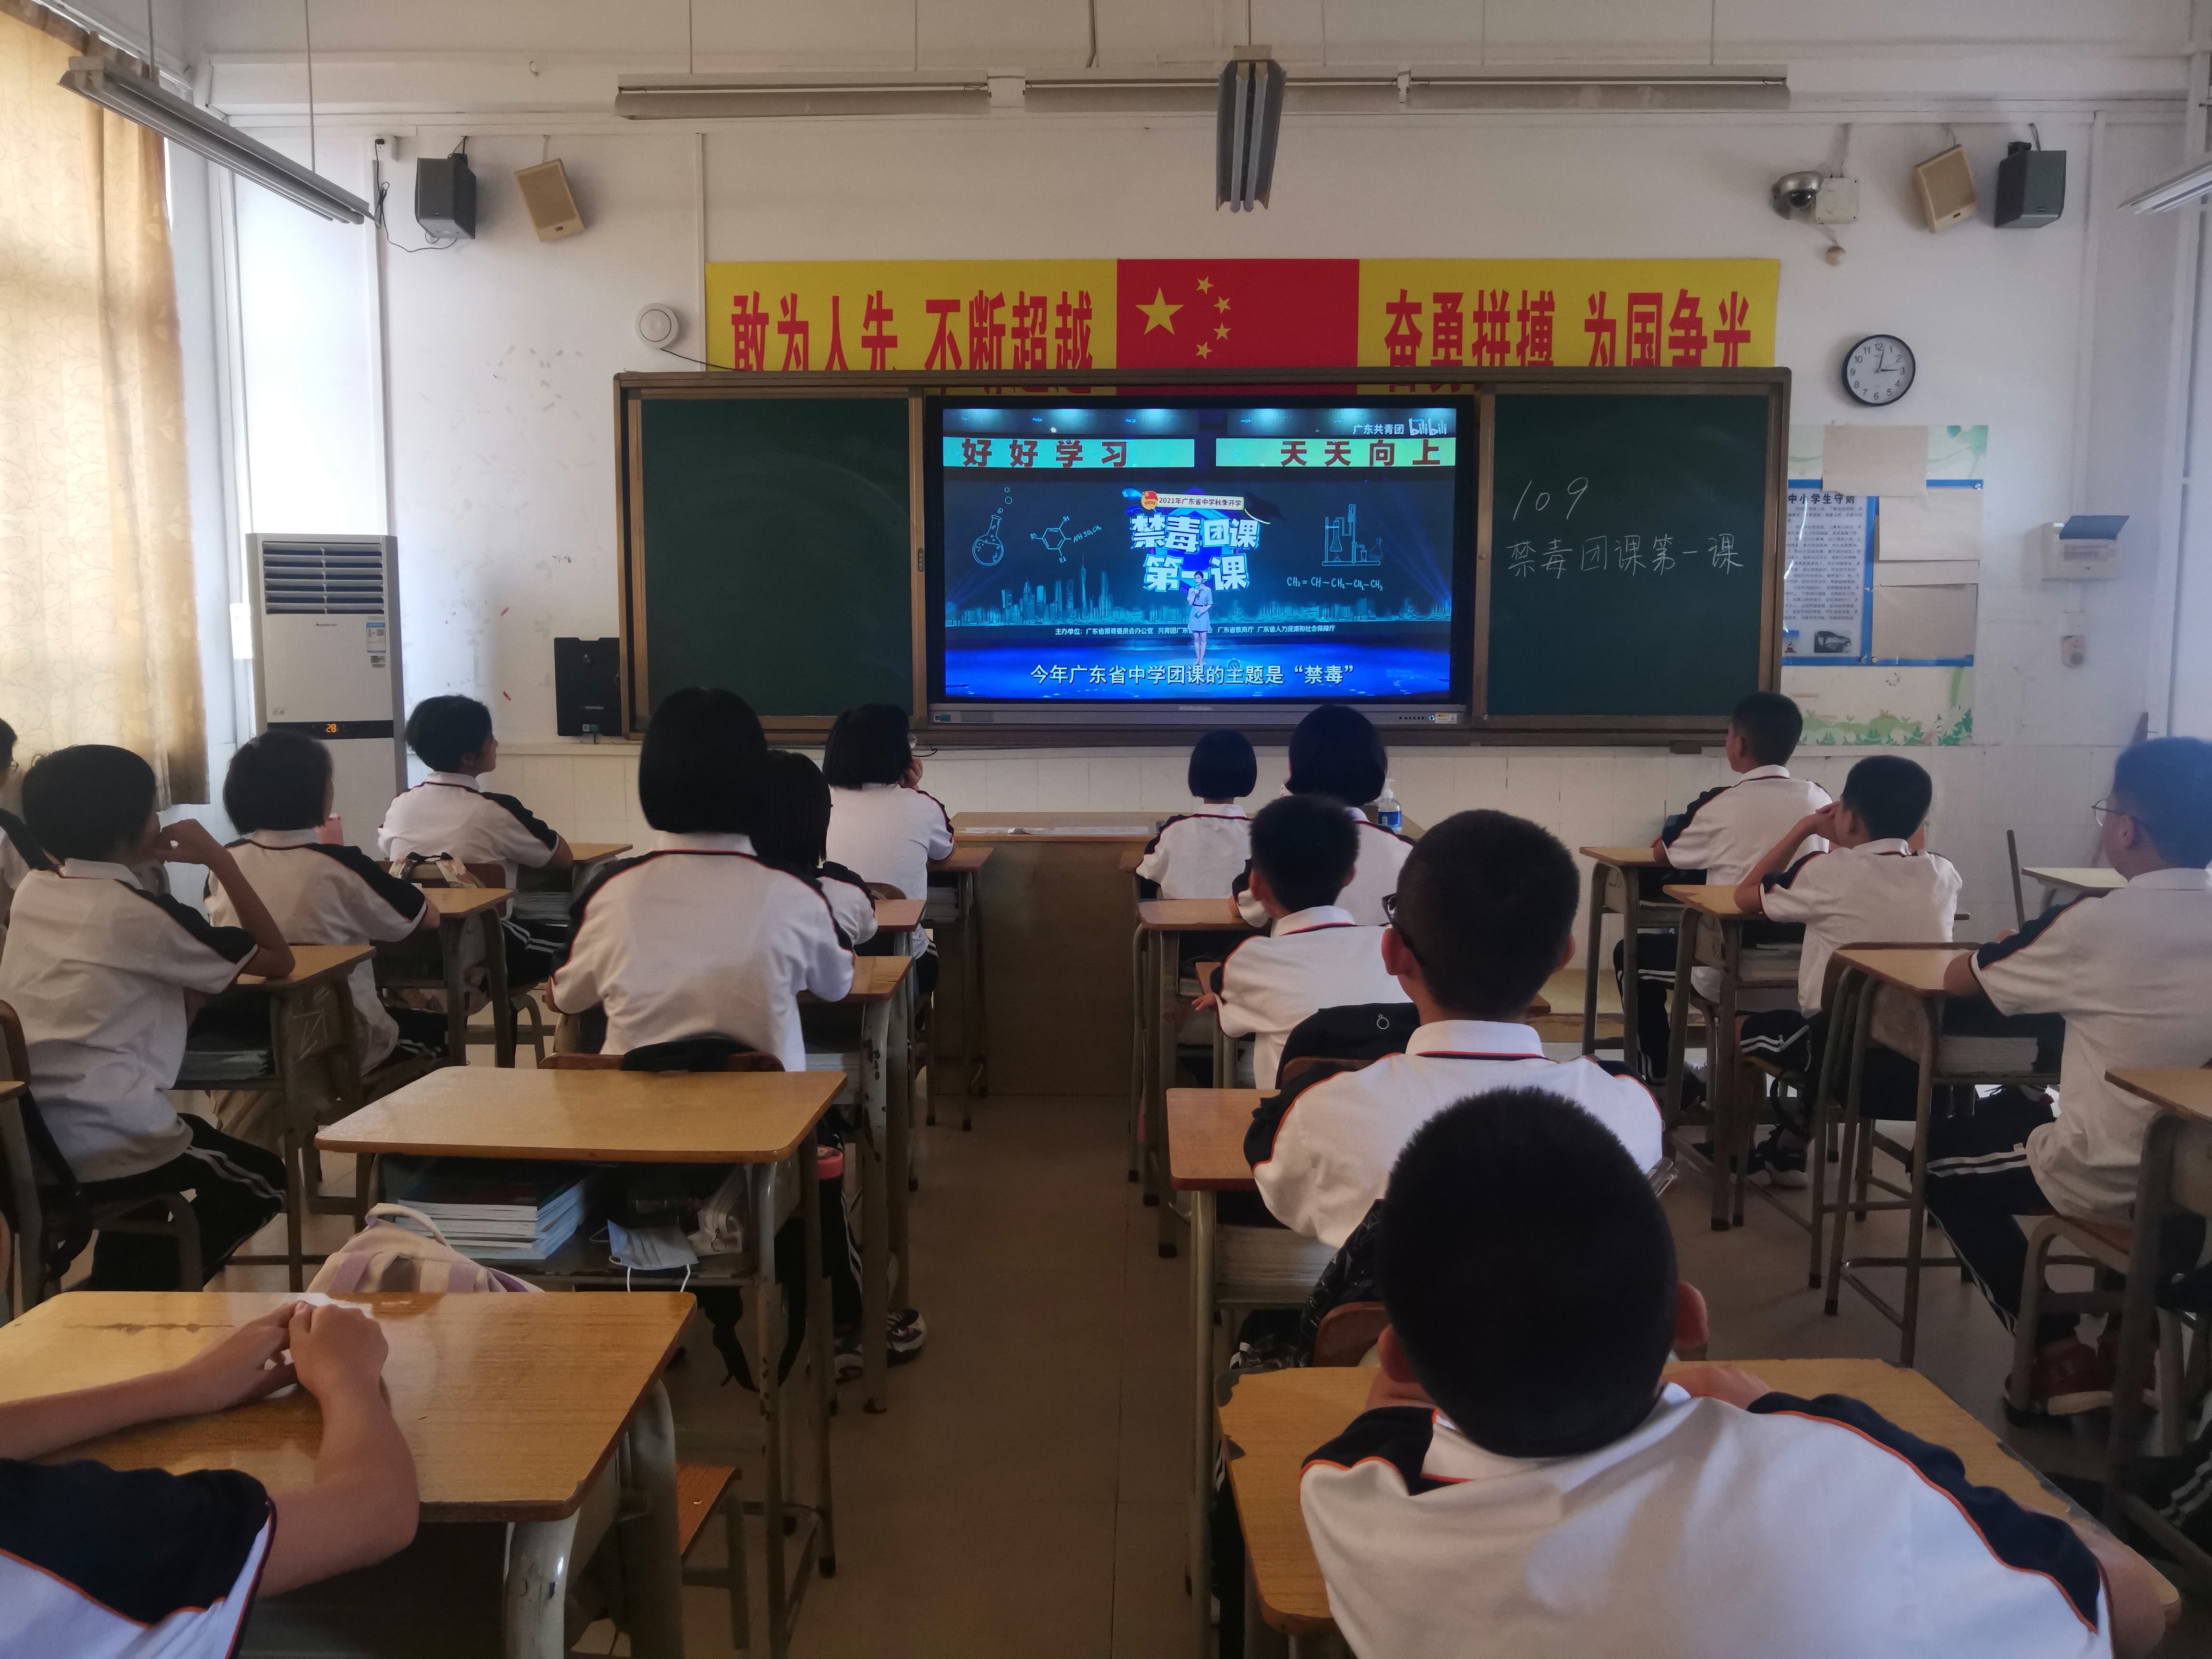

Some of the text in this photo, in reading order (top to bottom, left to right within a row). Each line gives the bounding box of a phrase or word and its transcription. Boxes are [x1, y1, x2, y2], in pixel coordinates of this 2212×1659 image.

[731, 289, 1093, 394] 敢为人先 不断超越
[1384, 289, 1751, 392] 奋勇拼搏 为国争光
[1874, 342, 1883, 351] 12
[1854, 355, 1863, 363] 10
[1896, 354, 1902, 362] 2
[1850, 368, 1856, 376] 9
[1854, 380, 1860, 389] 8
[1874, 392, 1879, 400] 6
[1886, 388, 1892, 396] 5
[1353, 423, 1404, 435] 广东共青团
[1408, 417, 1447, 436] bilibili
[962, 438, 1127, 467] 好好学习
[1280, 439, 1440, 466] 天天向上
[1159, 497, 1242, 507] 2021年广东省中学秋季开学
[1513, 476, 1588, 521] 109
[1788, 493, 1855, 504] 中小学生守则
[1130, 514, 1259, 553] 禁毒团课
[1505, 533, 1743, 579] 禁毒团课第一课
[1145, 555, 1248, 591] 第一课
[326, 723, 337, 733] 28
